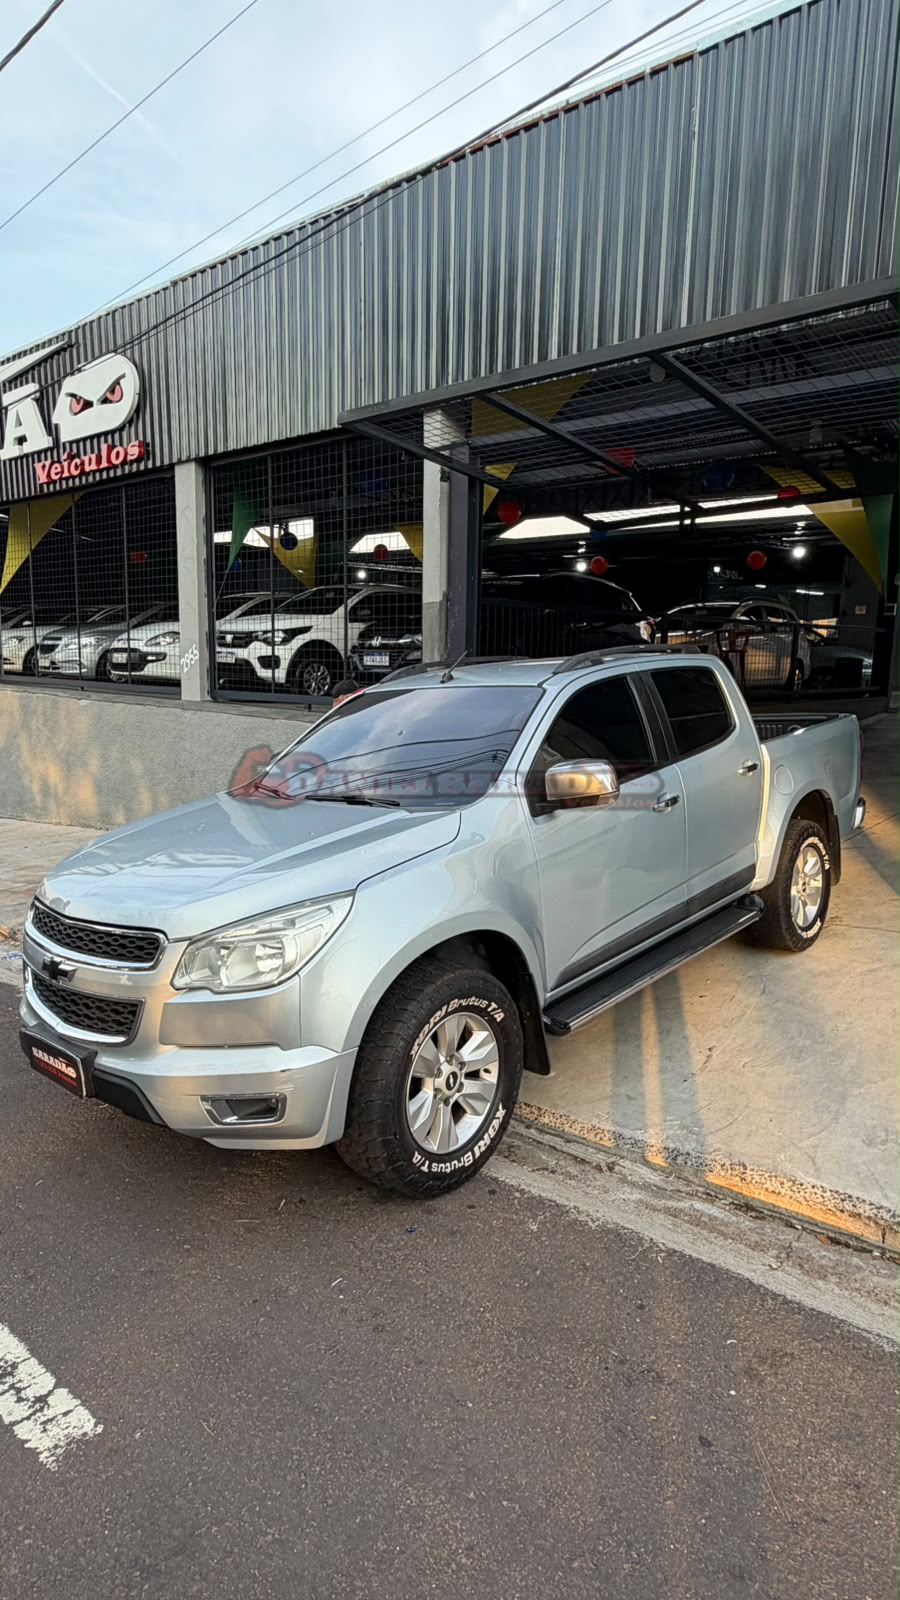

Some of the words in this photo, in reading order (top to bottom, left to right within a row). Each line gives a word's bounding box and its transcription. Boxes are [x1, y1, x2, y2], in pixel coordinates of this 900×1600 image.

[34, 440, 145, 484] Veículos
[180, 643, 199, 674] 2955
[447, 996, 488, 1012] Brutus
[487, 1002, 505, 1023] T/A
[411, 1151, 430, 1173] T/A
[431, 1151, 474, 1174] Brutus
